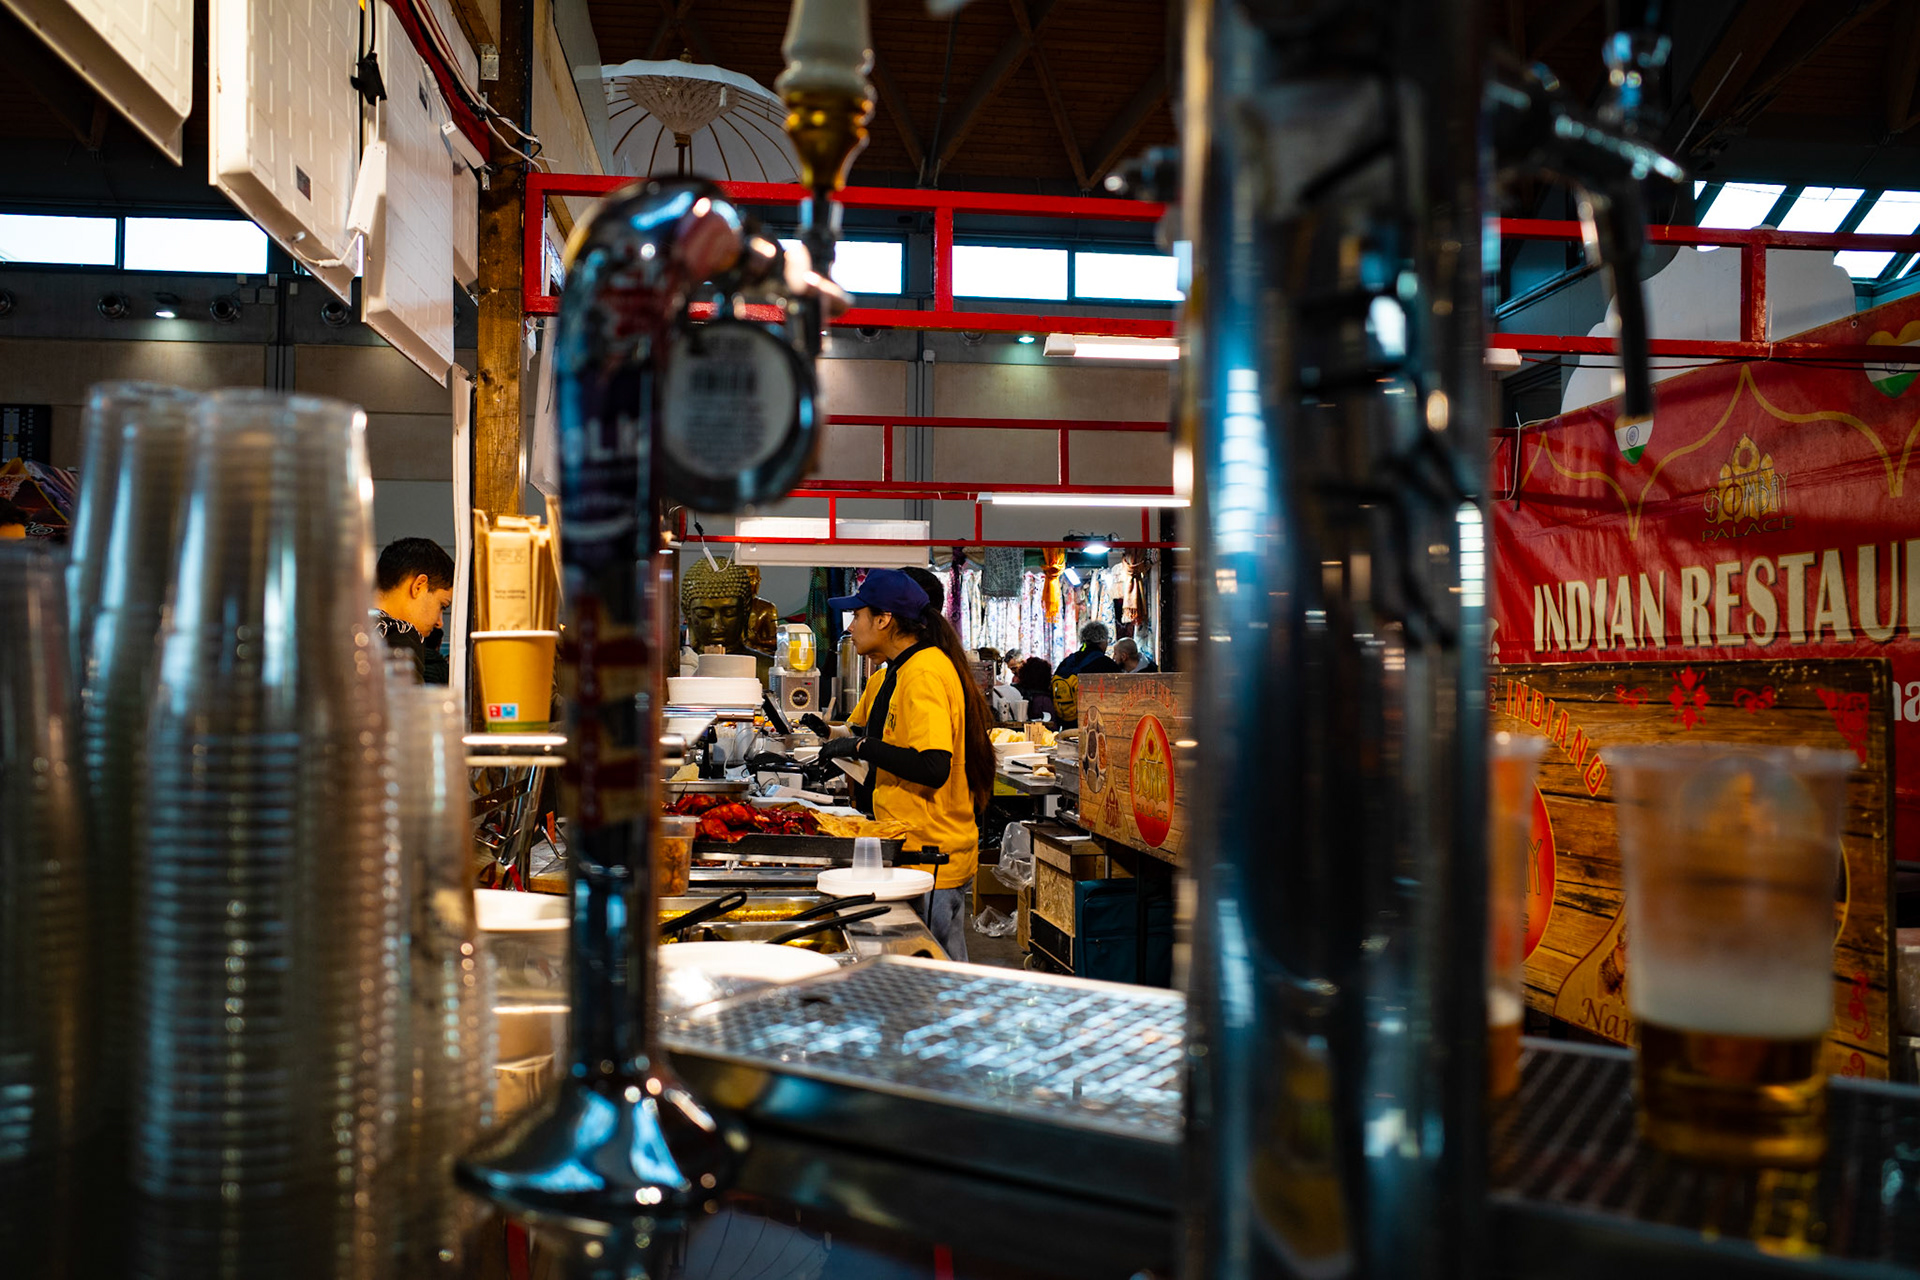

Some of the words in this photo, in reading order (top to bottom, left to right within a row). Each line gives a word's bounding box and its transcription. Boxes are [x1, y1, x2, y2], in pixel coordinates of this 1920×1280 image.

[1703, 471, 1790, 524] BOMBAY
[1701, 514, 1796, 542] PALACE
[1533, 569, 1668, 654] INDIAN
[1505, 678, 1607, 797] INDIANO
[1136, 802, 1168, 823] PALACE
